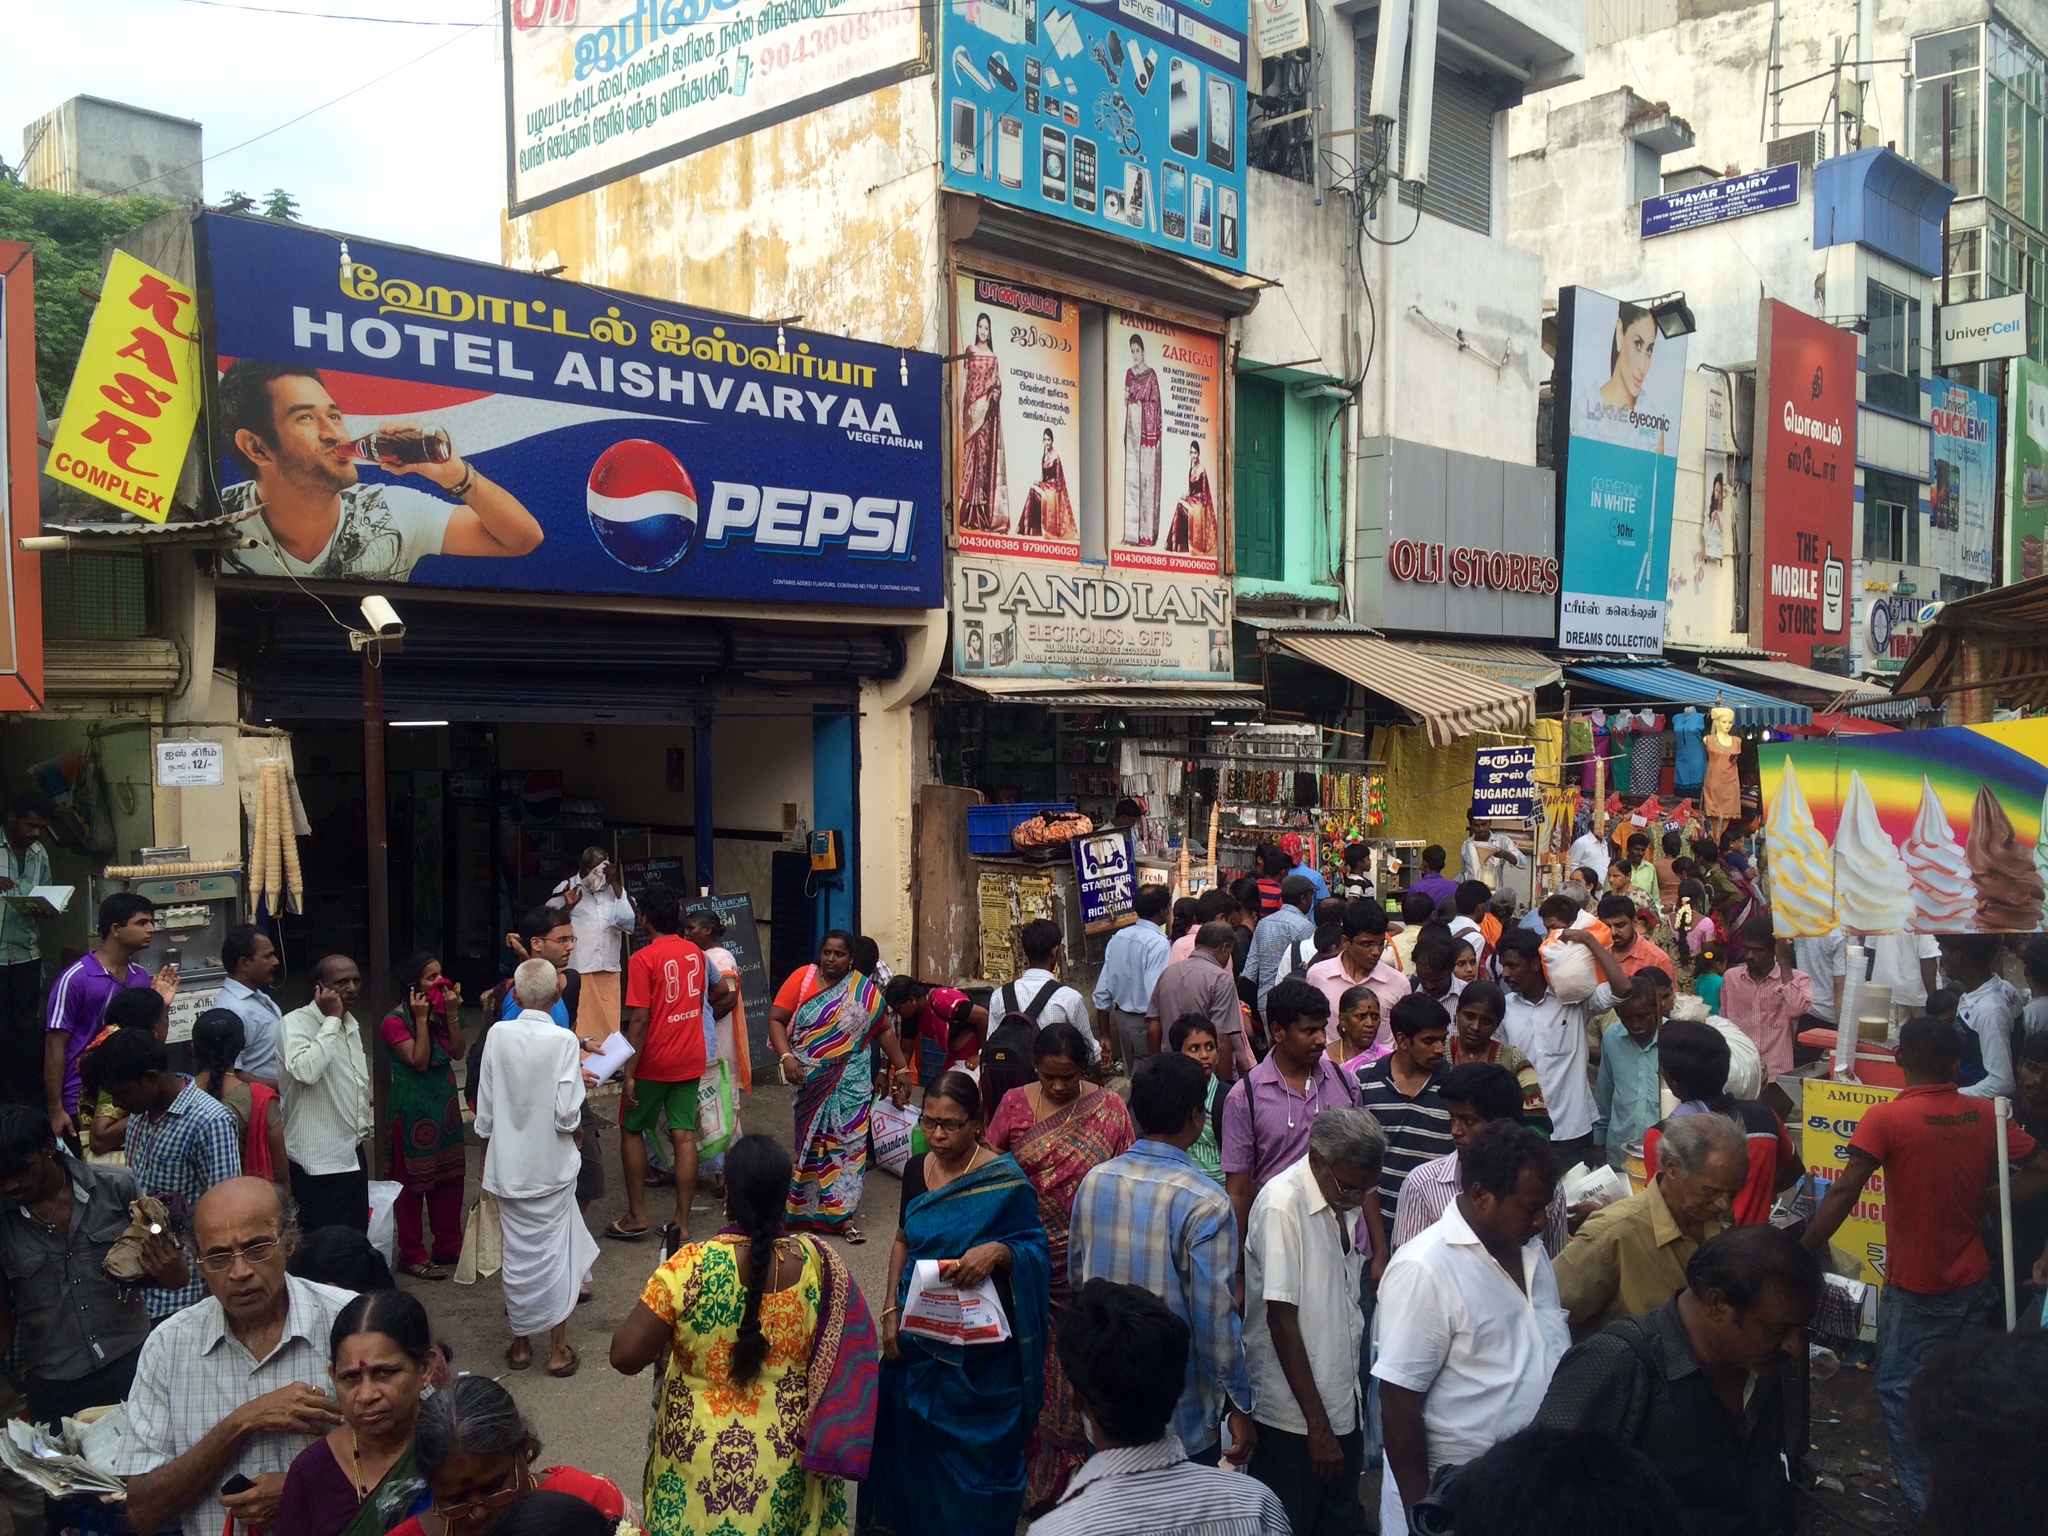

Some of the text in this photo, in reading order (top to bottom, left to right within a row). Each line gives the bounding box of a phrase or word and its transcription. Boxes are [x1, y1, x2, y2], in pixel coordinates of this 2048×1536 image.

[1726, 176, 1770, 194] DAIRY
[1120, 311, 1176, 337] PANDIAN
[1945, 318, 2021, 342] UniverCell
[1010, 325, 1072, 353] ஜரிகை
[650, 319, 877, 388] ஐஸ்வர்யா
[1162, 344, 1215, 368] ZARIGAI
[293, 306, 902, 436] HOTEL AISHVARYAA
[1811, 365, 1824, 401] தி
[1629, 410, 1670, 432] eyeconic
[1784, 400, 1842, 446] மொபைல்
[846, 430, 923, 450] VEGETARIAN
[1639, 427, 1656, 439] WHITE
[1787, 441, 1837, 481] ஸ்டோர்
[54, 452, 164, 515] COMPLEX
[1591, 477, 1643, 499] GO EYECONIC
[1591, 491, 1636, 514] IN WHITE
[705, 481, 916, 557] PEPSI
[1022, 540, 1078, 557] 9791006020
[1796, 531, 1819, 565] THE
[1114, 552, 1216, 571] 9043008385 9791006020
[1390, 538, 1559, 595] OLI STORES
[1771, 564, 1818, 600] MOBILE
[962, 566, 1229, 626] PANDIAN
[1778, 602, 1818, 636] STORE
[1028, 623, 1124, 645] ELECTRONICS
[1138, 630, 1172, 647] GIFTS
[1566, 631, 1658, 649] DREAMS COLLECTION
[165, 749, 187, 760] ஐஸ்
[192, 759, 212, 769] 12/-
[1474, 787, 1535, 800] SUGARCANE
[1488, 803, 1520, 815] JUICE
[1664, 821, 1680, 832] 130
[1081, 879, 1111, 893] STAND
[1140, 871, 1163, 883] Fresh
[685, 902, 708, 914] HOTEL
[1087, 899, 1133, 918] RICKSHAW
[664, 953, 701, 1004] 82
